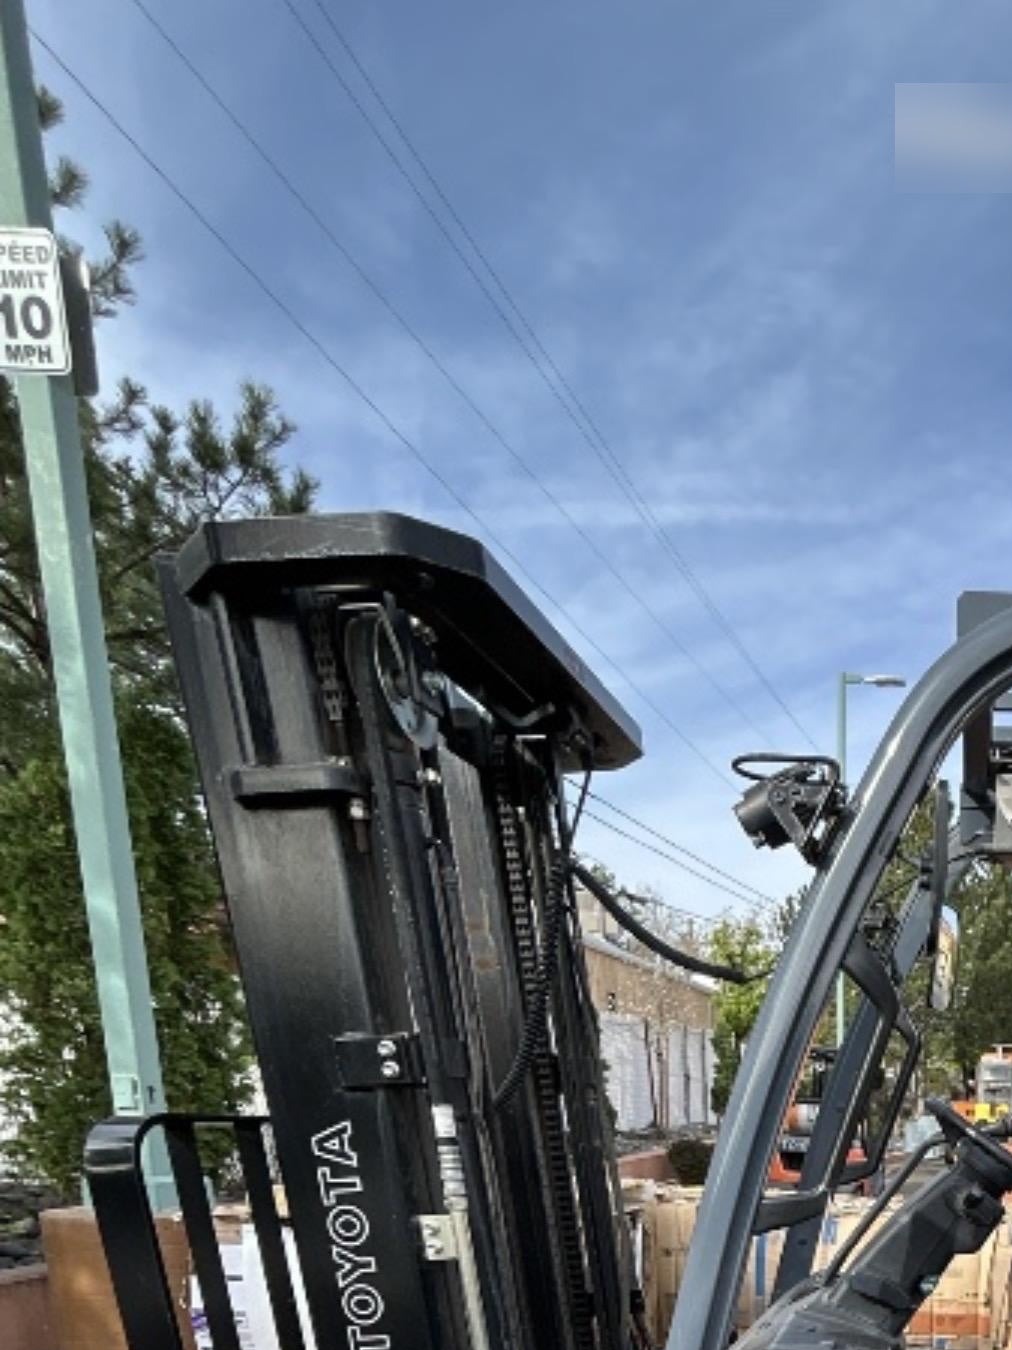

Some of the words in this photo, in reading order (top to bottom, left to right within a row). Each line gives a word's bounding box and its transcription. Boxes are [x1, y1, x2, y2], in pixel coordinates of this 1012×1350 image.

[0, 245, 49, 264] PEED
[0, 269, 48, 289] IMIT
[0, 293, 53, 340] 10
[5, 344, 54, 364] MPH
